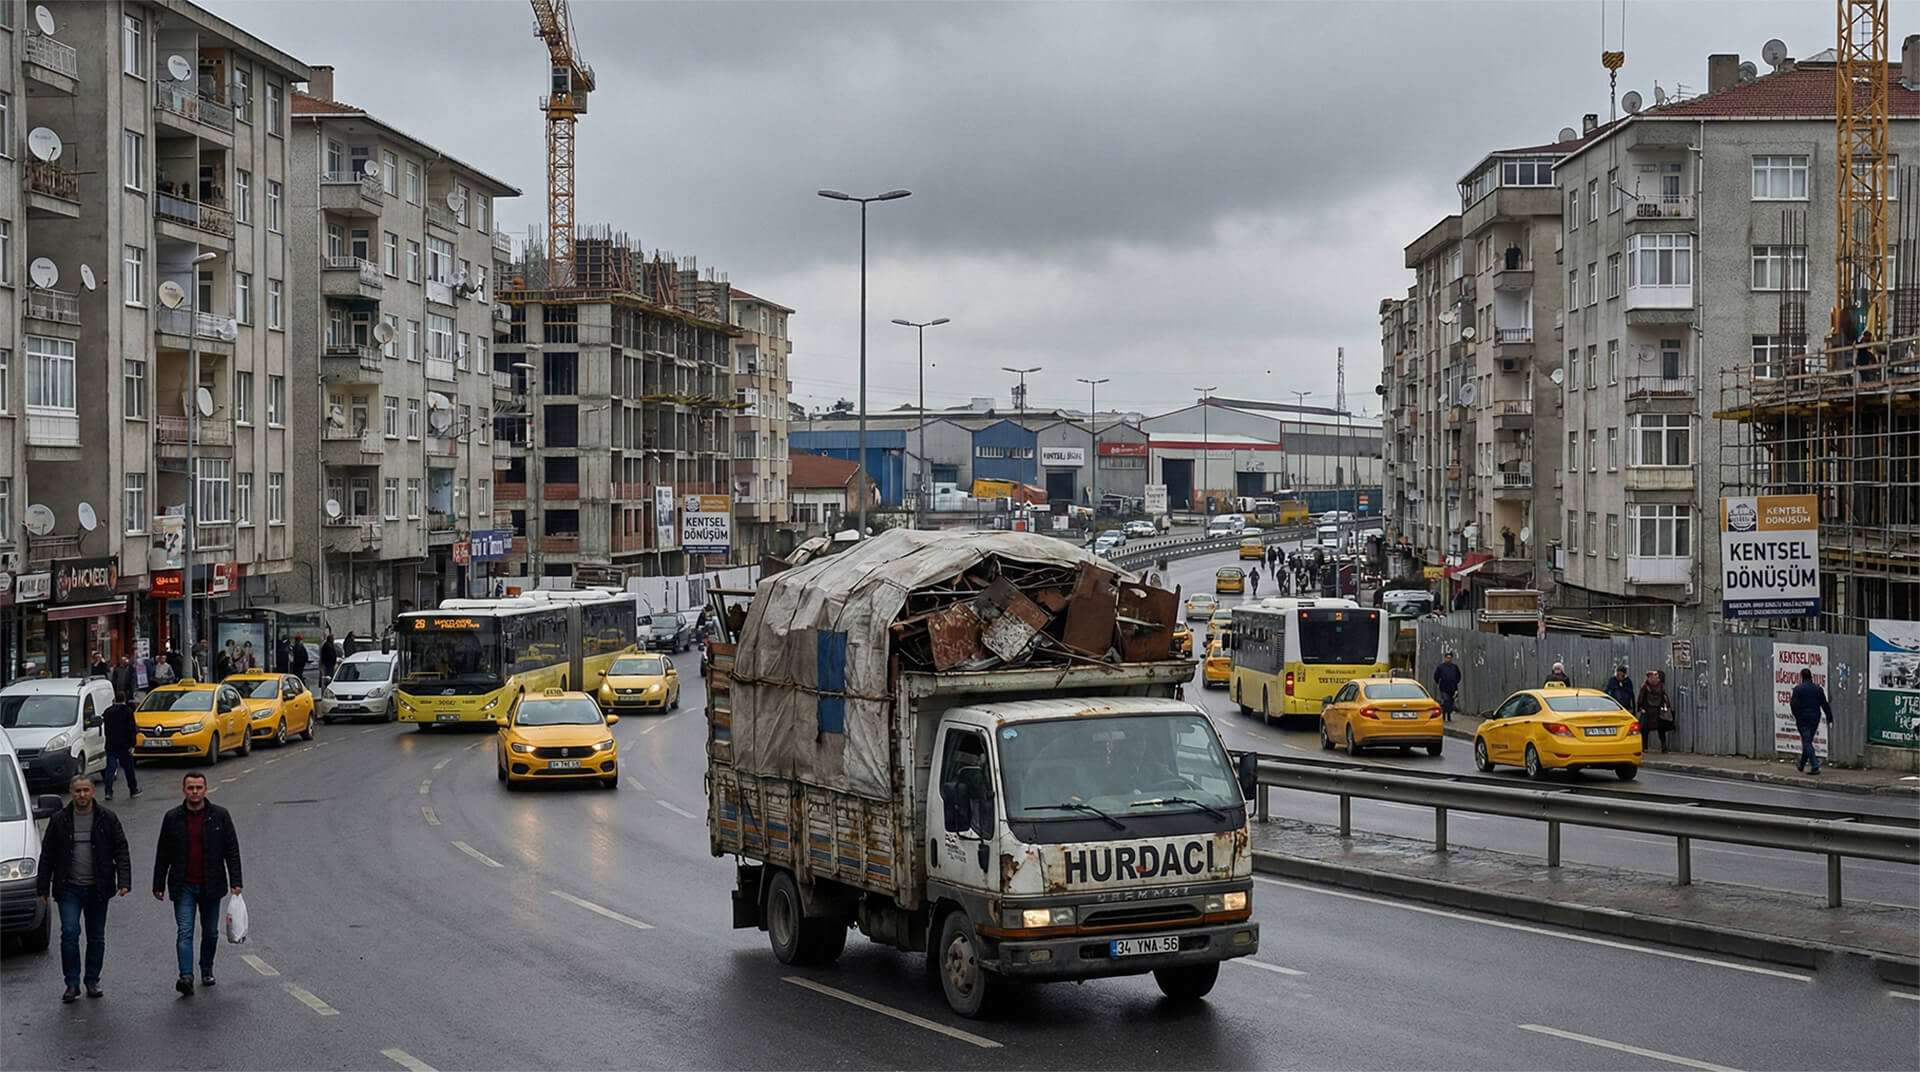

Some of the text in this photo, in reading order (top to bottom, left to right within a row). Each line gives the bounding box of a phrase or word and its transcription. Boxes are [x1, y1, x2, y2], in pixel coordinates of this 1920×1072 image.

[686, 517, 726, 527] KENTSEL
[684, 528, 728, 542] DÖNÜŞÜM
[1730, 541, 1811, 561] KENTSEL
[1727, 564, 1816, 592] DÖNÜŞÜM
[1064, 840, 1214, 884] HURDACI
[1117, 937, 1178, 955] 34 YNA 56
